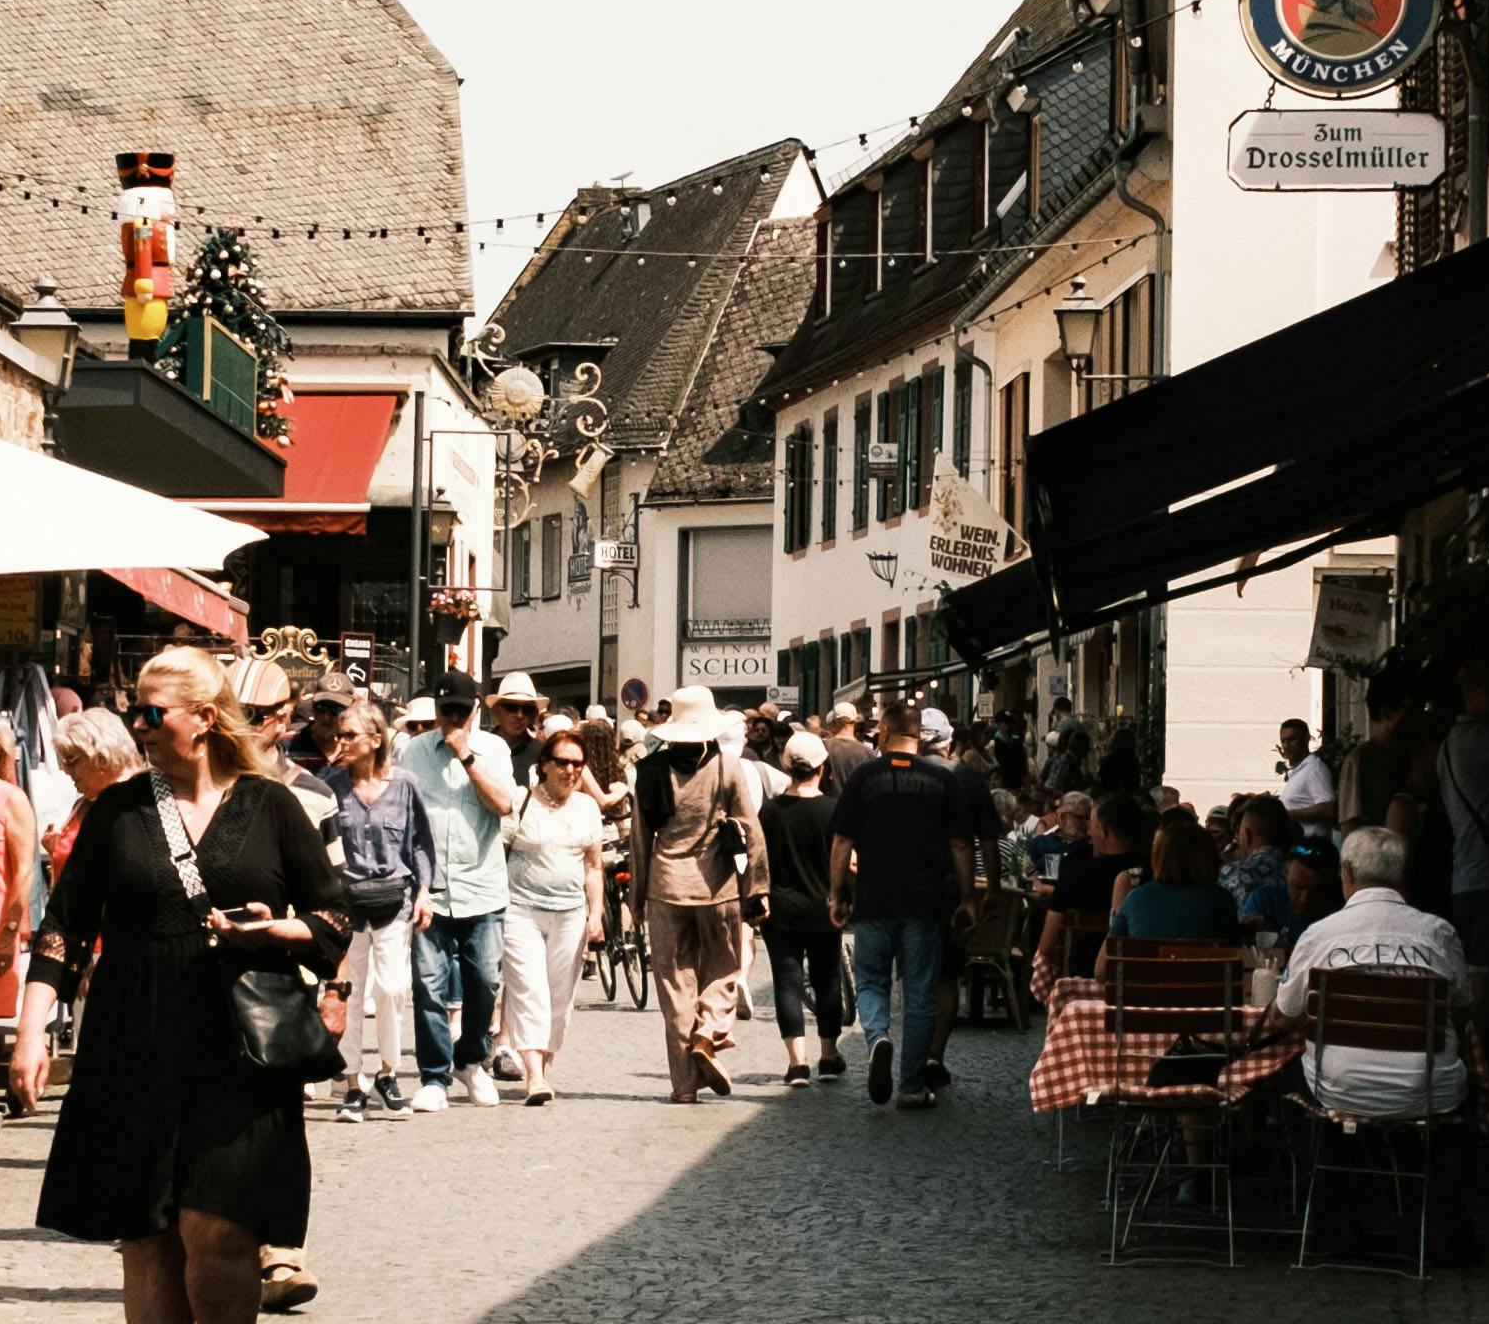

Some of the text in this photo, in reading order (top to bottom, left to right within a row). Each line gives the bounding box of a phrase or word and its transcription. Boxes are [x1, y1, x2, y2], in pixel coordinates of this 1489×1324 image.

[1271, 38, 1410, 83] MÜNCHEN
[1313, 123, 1363, 143] Zum
[1245, 146, 1430, 170] Drosselmüller
[959, 524, 1001, 547] WEIN.
[601, 545, 636, 561] HOTEL
[929, 535, 998, 564] ERLEBNIS.
[1327, 943, 1433, 968] OCEAN
